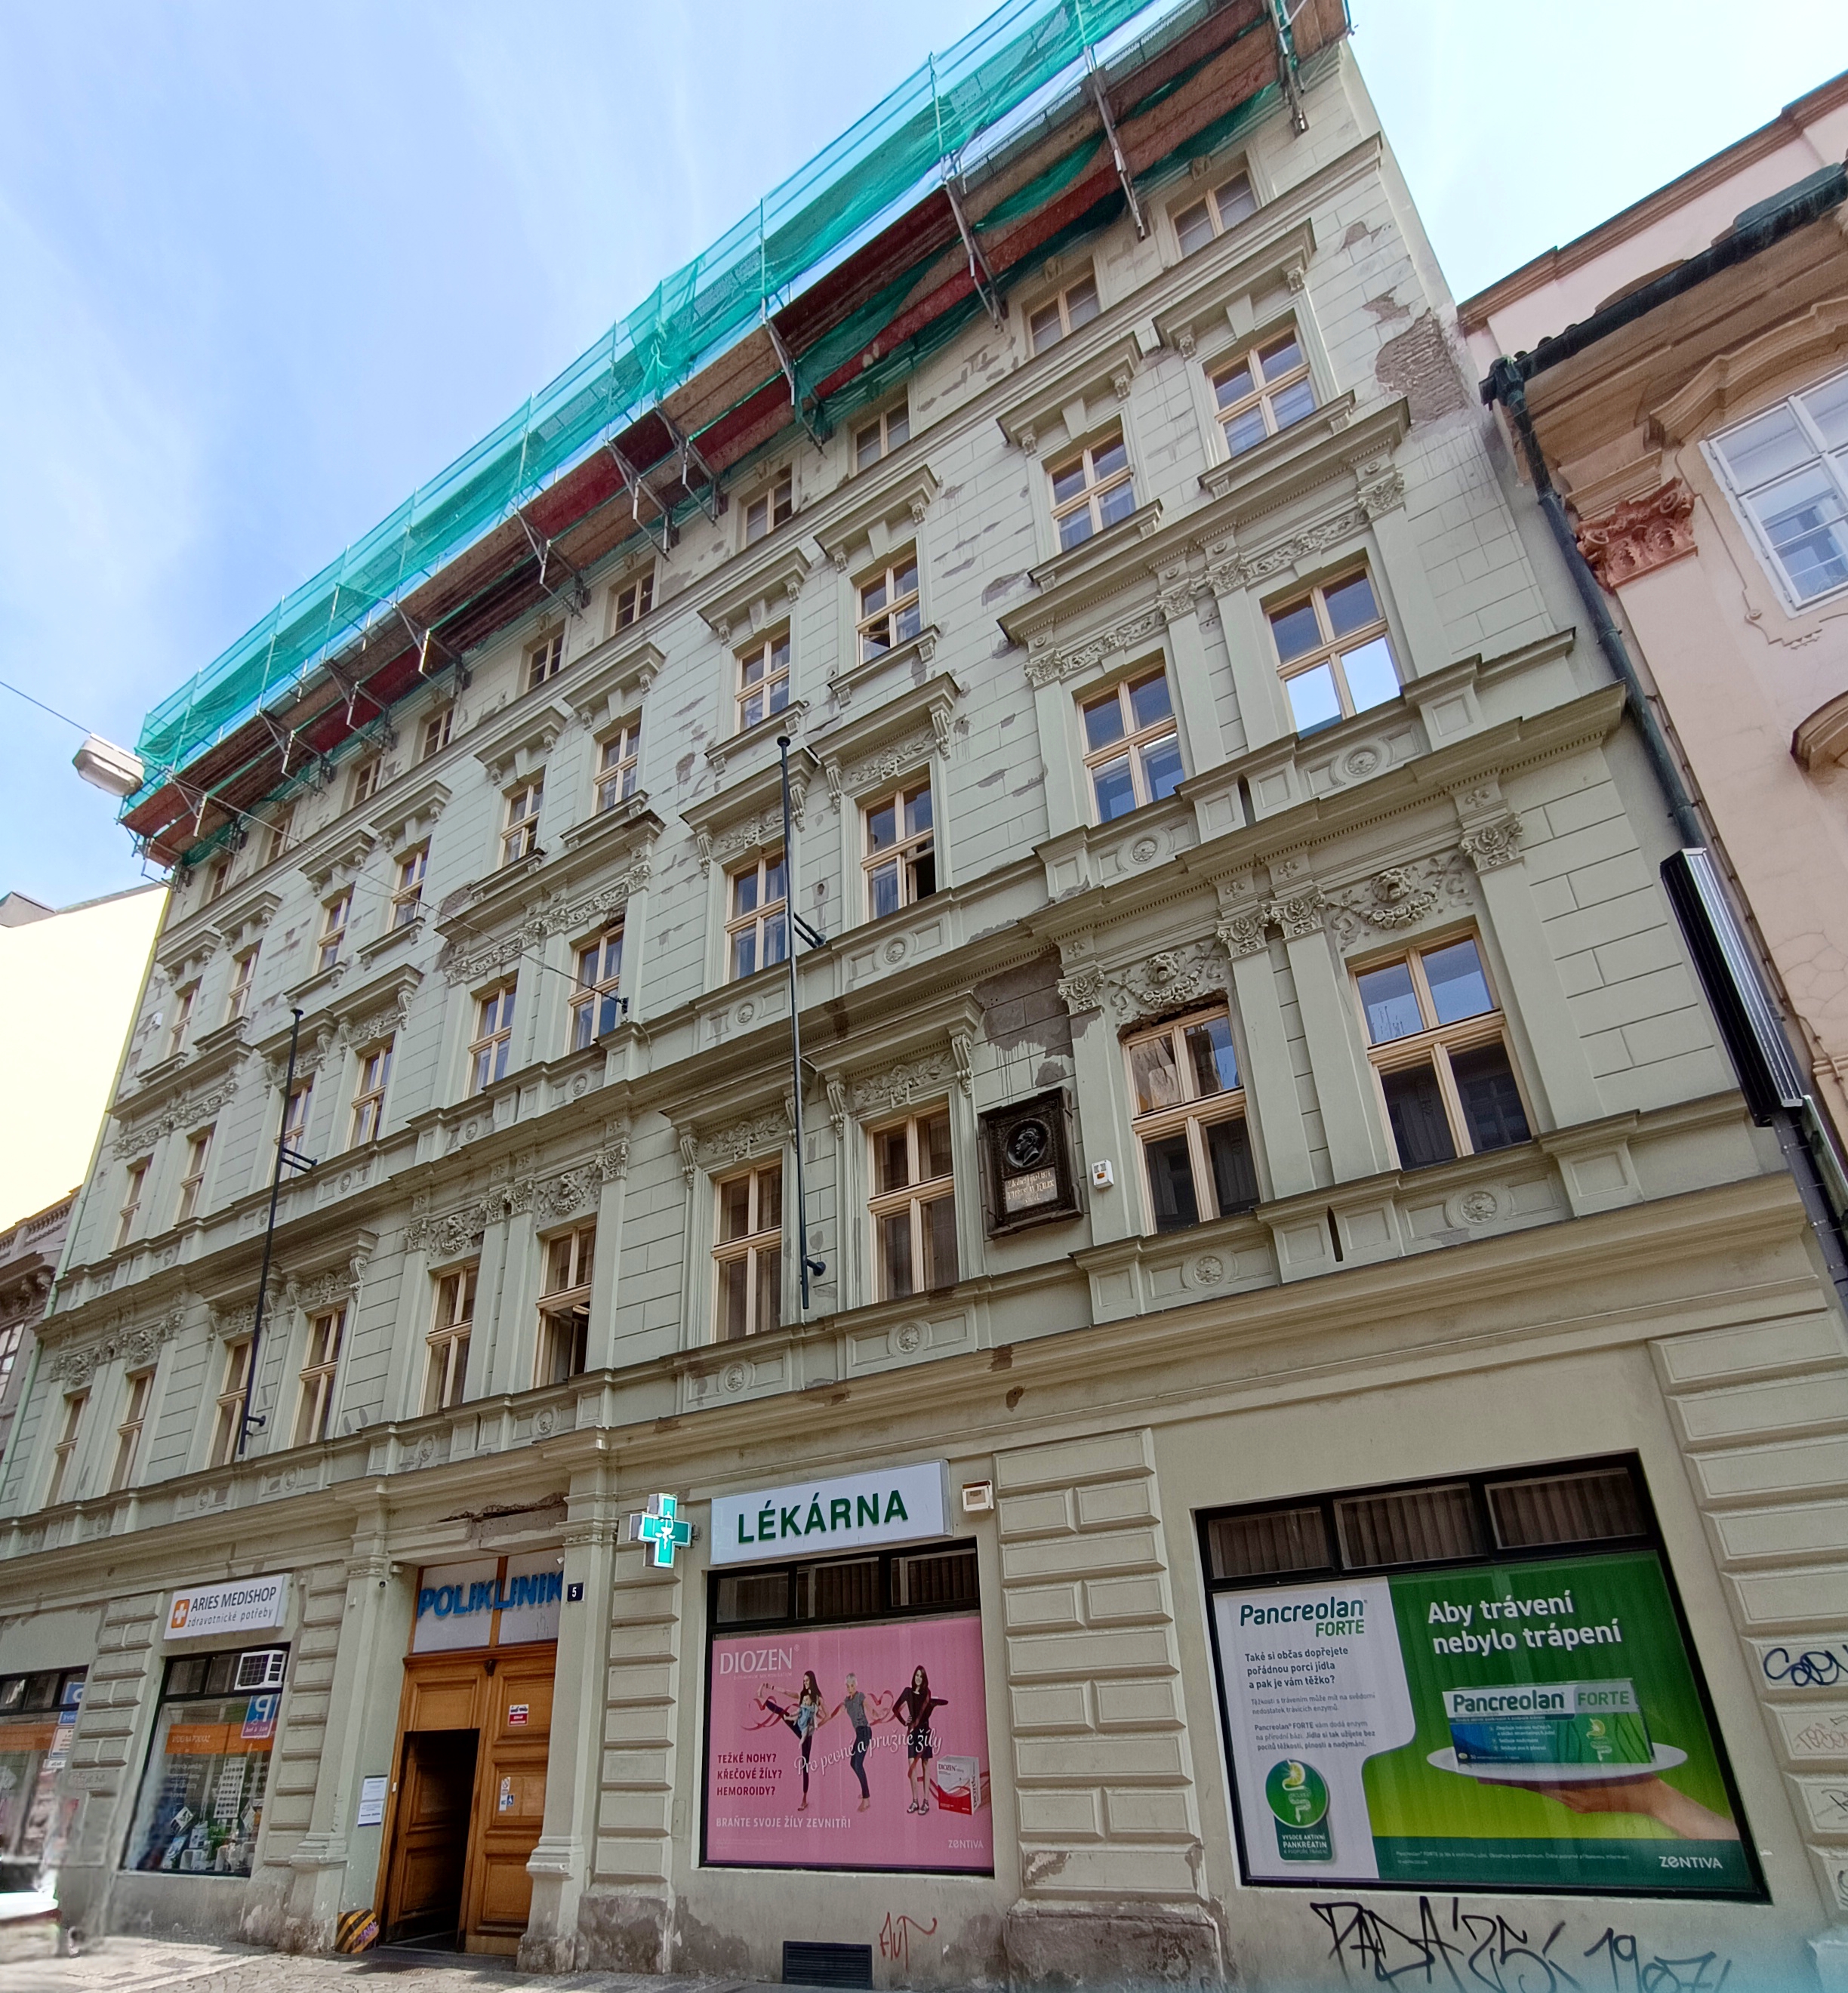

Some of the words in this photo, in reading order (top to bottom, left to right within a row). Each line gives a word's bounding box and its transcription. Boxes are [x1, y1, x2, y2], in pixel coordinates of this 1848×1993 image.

[738, 1489, 908, 1543] LÉKÁRNA
[191, 1595, 220, 1612] ARIES
[220, 1586, 276, 1608] MEDISHOP
[571, 1586, 578, 1597] 5
[1428, 1601, 1472, 1626] Aby
[1480, 1589, 1574, 1619] trávení
[187, 1611, 236, 1627] zdravotnické
[240, 1606, 273, 1622] potřeby
[1316, 1619, 1365, 1637] FORTE
[1433, 1628, 1517, 1656] nebylo
[1523, 1618, 1622, 1651] trápení
[1245, 1652, 1265, 1662] Také
[1267, 1651, 1275, 1660] si
[1277, 1650, 1303, 1659] občas
[1304, 1646, 1348, 1659] dopřejete
[1247, 1665, 1289, 1677] pořádnou
[1291, 1662, 1314, 1674] porci
[1315, 1661, 1335, 1672] jídla
[1256, 1678, 1273, 1690] pak
[1274, 1678, 1283, 1690] je
[1284, 1677, 1303, 1687] vám
[1304, 1674, 1335, 1685] těžko?
[1577, 1691, 1630, 1706] FORTE
[747, 1753, 777, 1763] NOHY?
[794, 1756, 818, 1775] Pro
[821, 1739, 855, 1776] pevné
[857, 1741, 867, 1754] a
[867, 1729, 914, 1757] pružné
[915, 1728, 942, 1754] žíly
[717, 1767, 756, 1779] KŘEČOVÉ
[759, 1767, 782, 1779] ŽÍLY?
[717, 1786, 775, 1796] HEMOROIDY?
[716, 1815, 750, 1828] BRAŇTE
[753, 1817, 781, 1828] SVOJE
[784, 1815, 803, 1828] ŽÍLY
